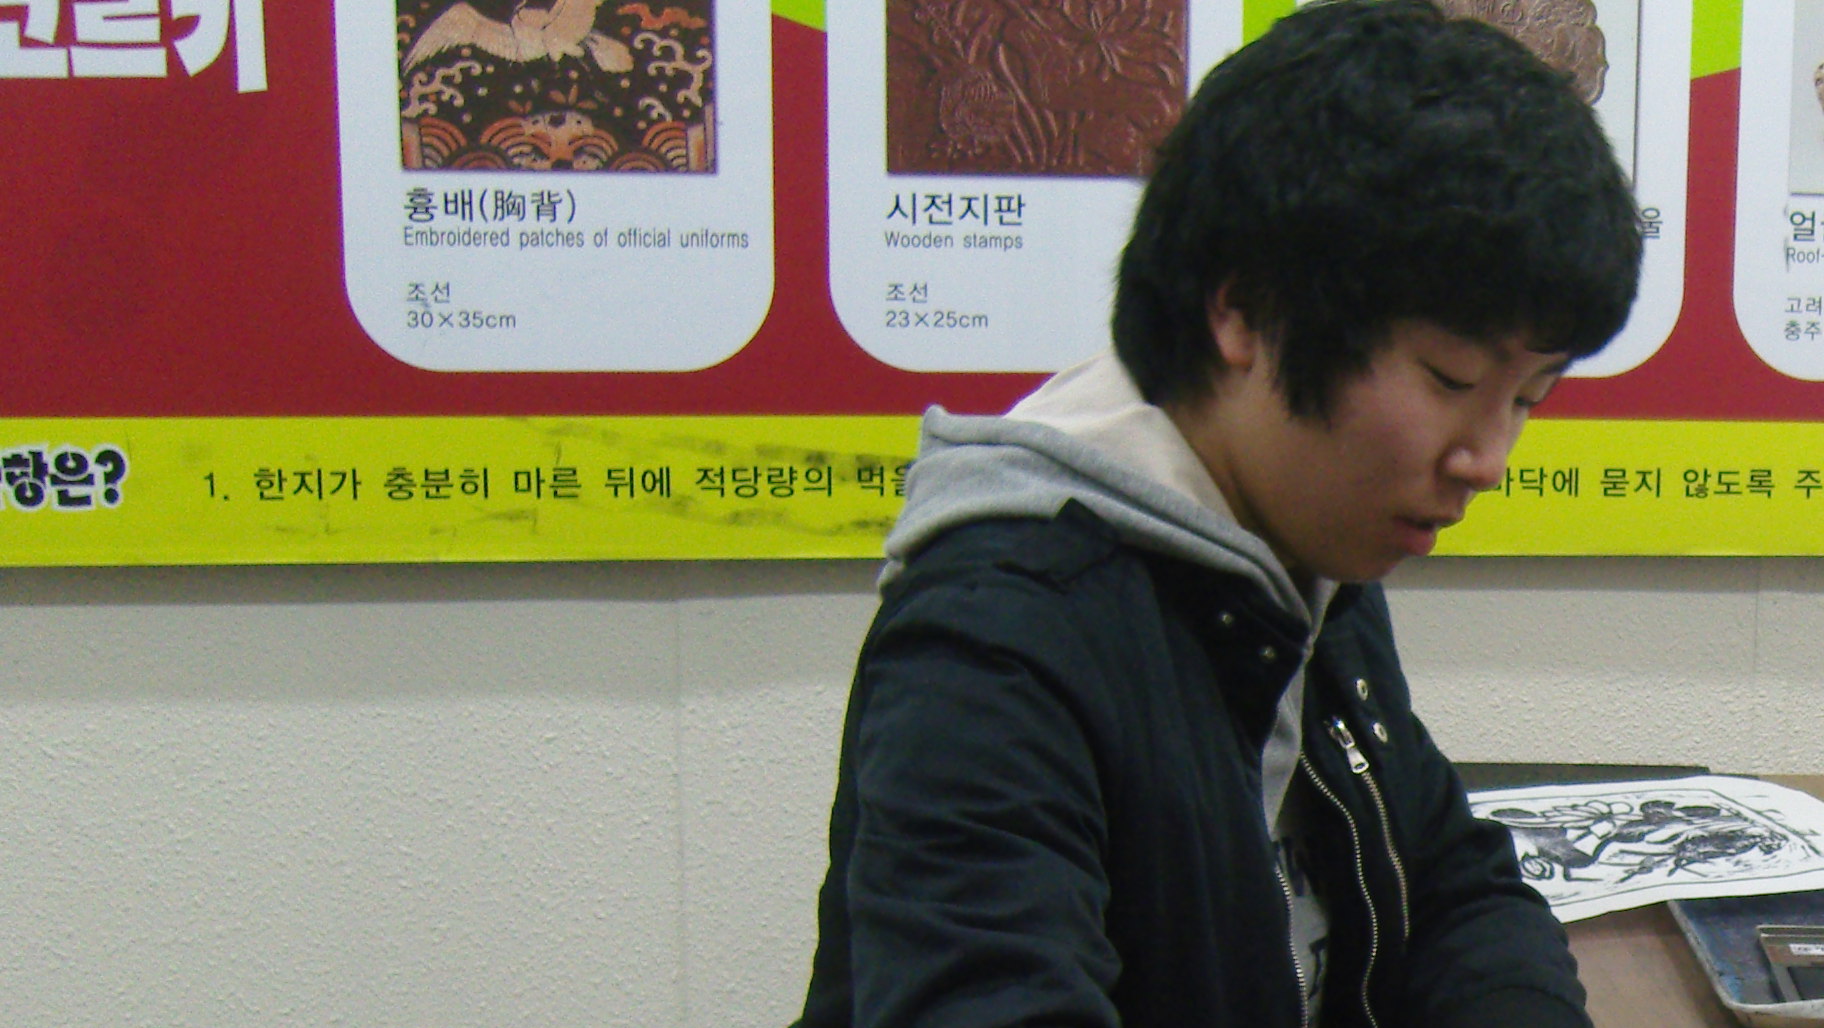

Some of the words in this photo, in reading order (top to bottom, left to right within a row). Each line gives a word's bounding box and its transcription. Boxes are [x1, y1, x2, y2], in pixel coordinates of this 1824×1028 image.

[886, 193, 1025, 226] 시전지판
[404, 226, 510, 247] Embroidered
[520, 227, 584, 250] patches
[594, 227, 608, 248] of
[617, 227, 671, 248] official
[680, 228, 749, 249] uniforms
[884, 231, 954, 249] Wooden
[963, 232, 1024, 251] stamps
[407, 281, 450, 304] 조선
[886, 282, 929, 303] 조선
[1785, 296, 1823, 316] 고려
[0, 449, 126, 507] 항은?
[204, 472, 229, 500] 1.
[253, 467, 361, 500] 한지가
[383, 467, 489, 500] 충분히
[514, 467, 582, 499] 마른
[605, 466, 670, 498] 뒤에
[696, 466, 832, 498] 적당량의
[1600, 467, 1661, 498] 묻지
[1682, 467, 1775, 499] 않도록
